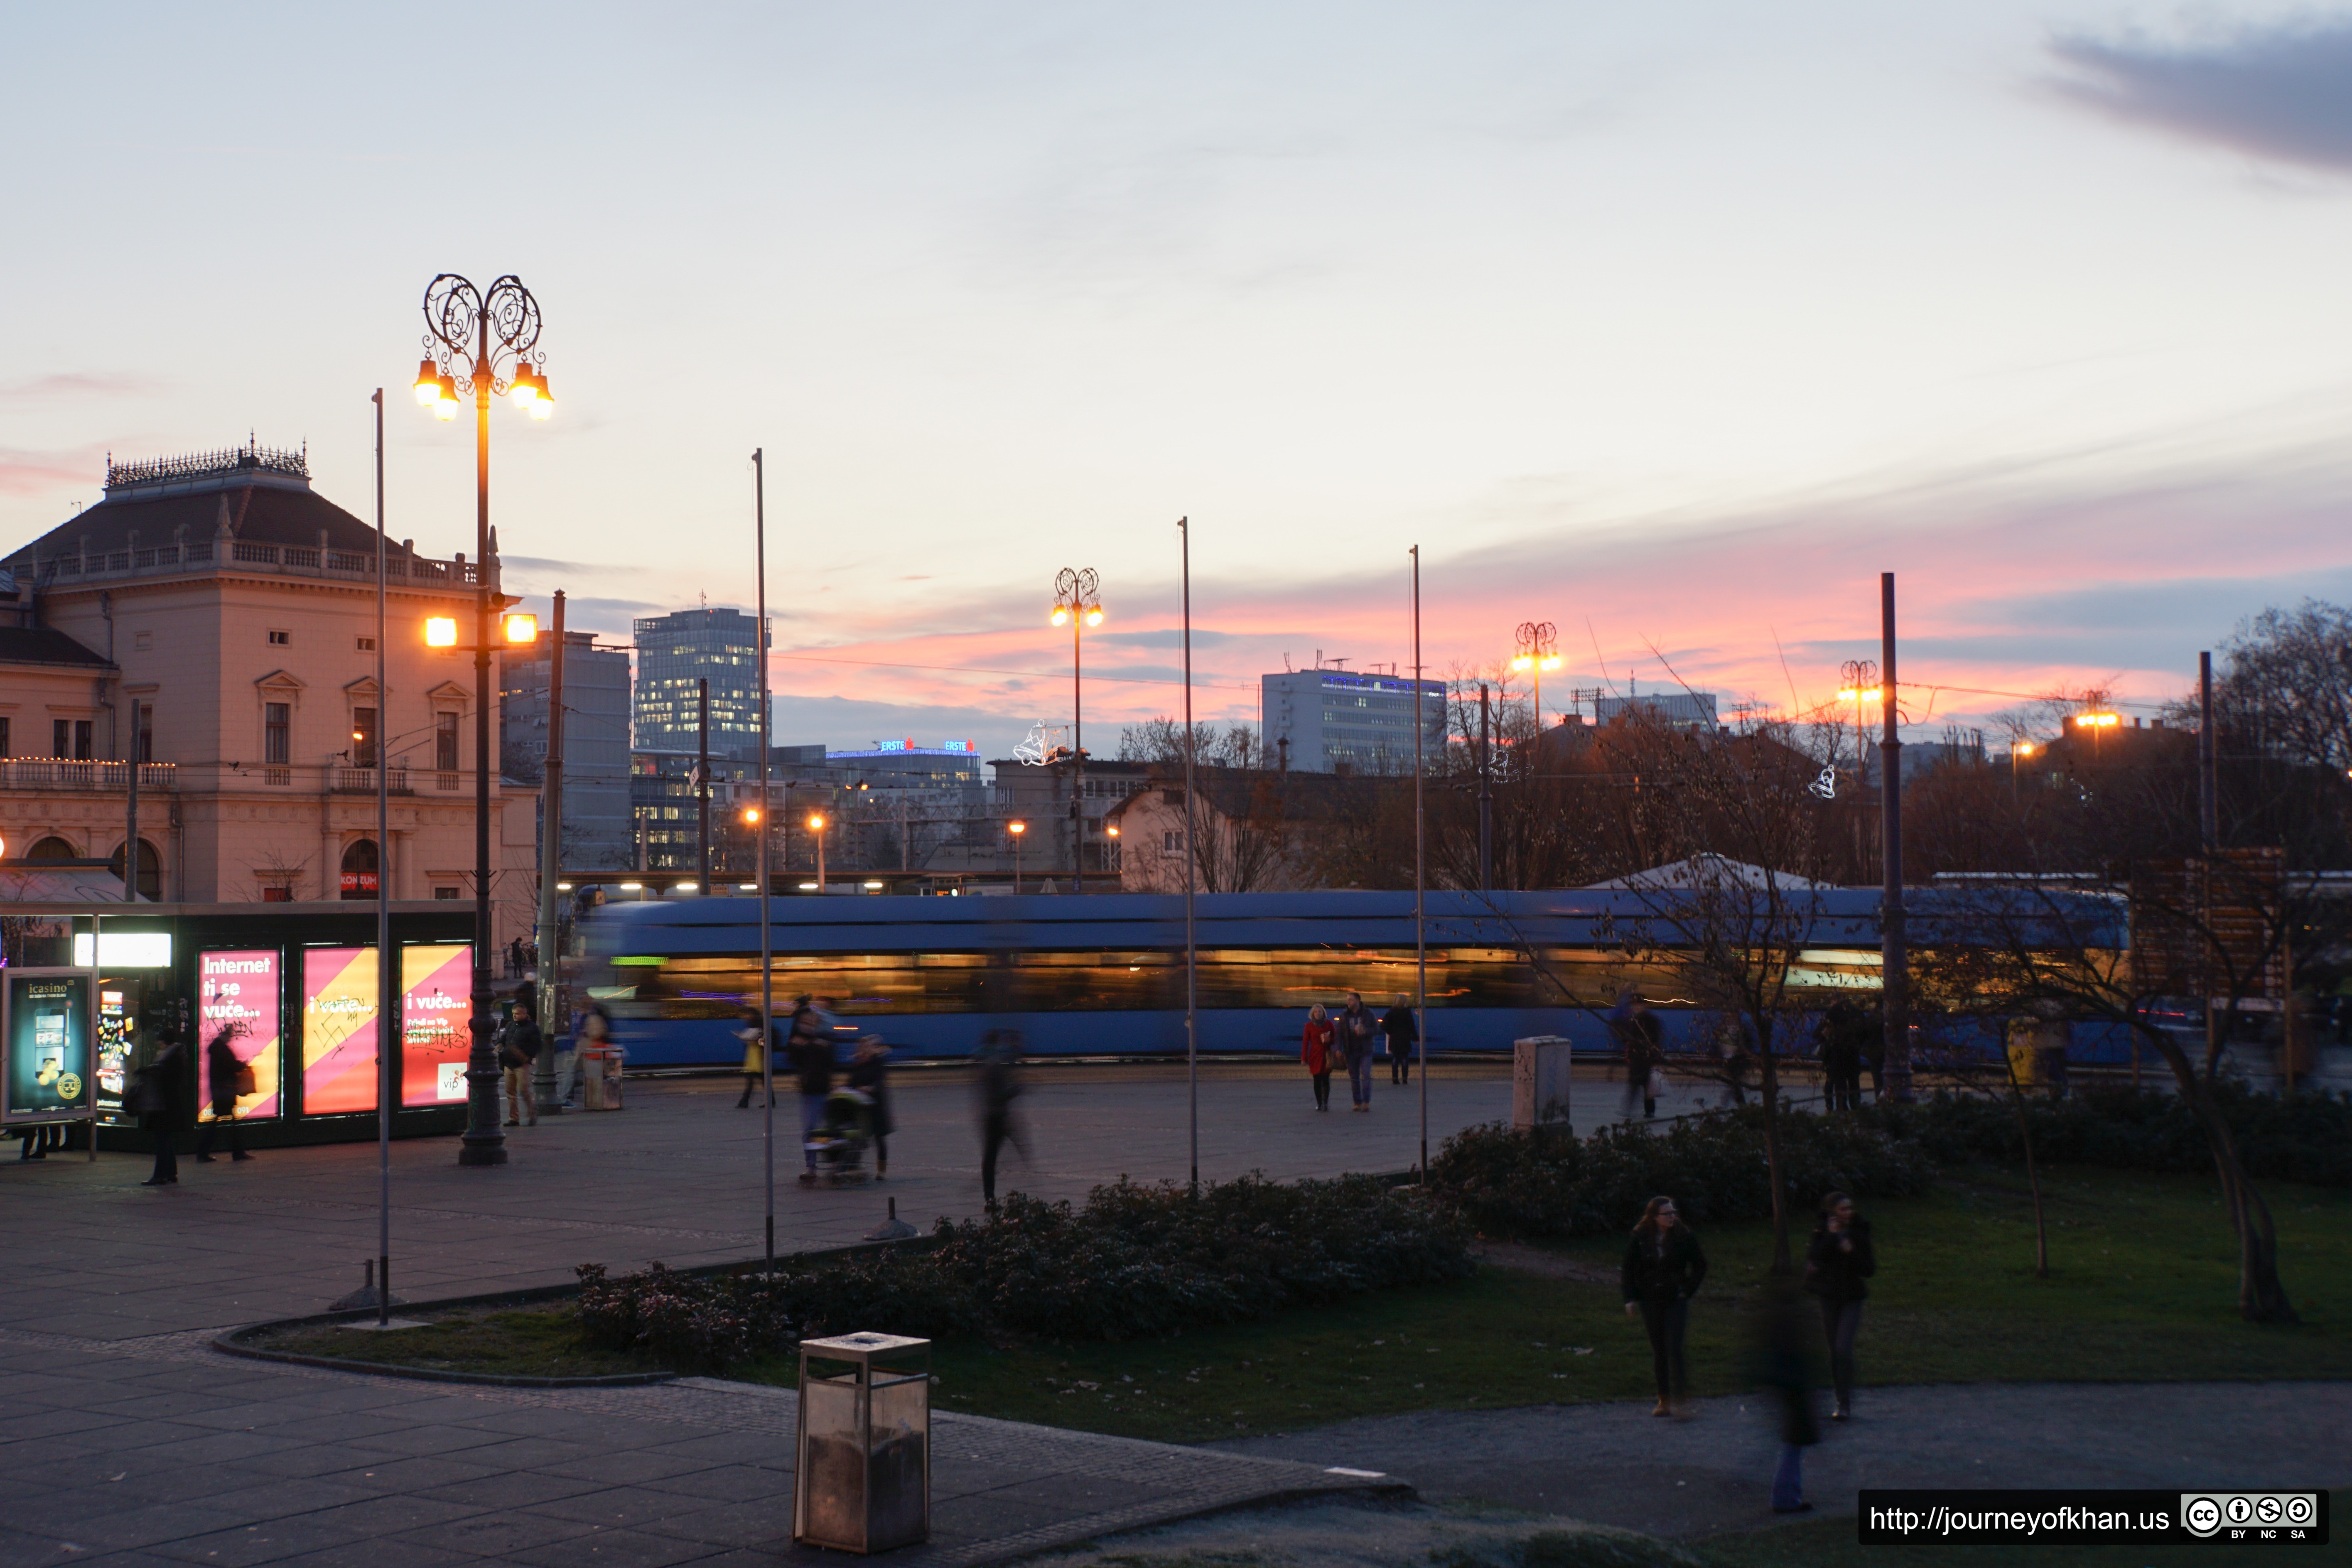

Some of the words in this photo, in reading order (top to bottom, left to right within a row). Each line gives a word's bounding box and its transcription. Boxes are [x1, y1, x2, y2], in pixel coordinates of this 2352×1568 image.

[881, 741, 905, 751] ERSTE
[945, 741, 967, 751] ERSTE
[341, 876, 376, 884] KONZUM
[205, 957, 270, 974] Internet
[29, 983, 67, 993] icasino
[204, 978, 215, 996] ti
[221, 983, 240, 996] se
[309, 996, 314, 1013] i
[408, 992, 412, 1009] i
[416, 991, 466, 1009] vuče...
[203, 999, 260, 1018] vuče...
[437, 1018, 448, 1026] Vip
[444, 1078, 458, 1091] vip
